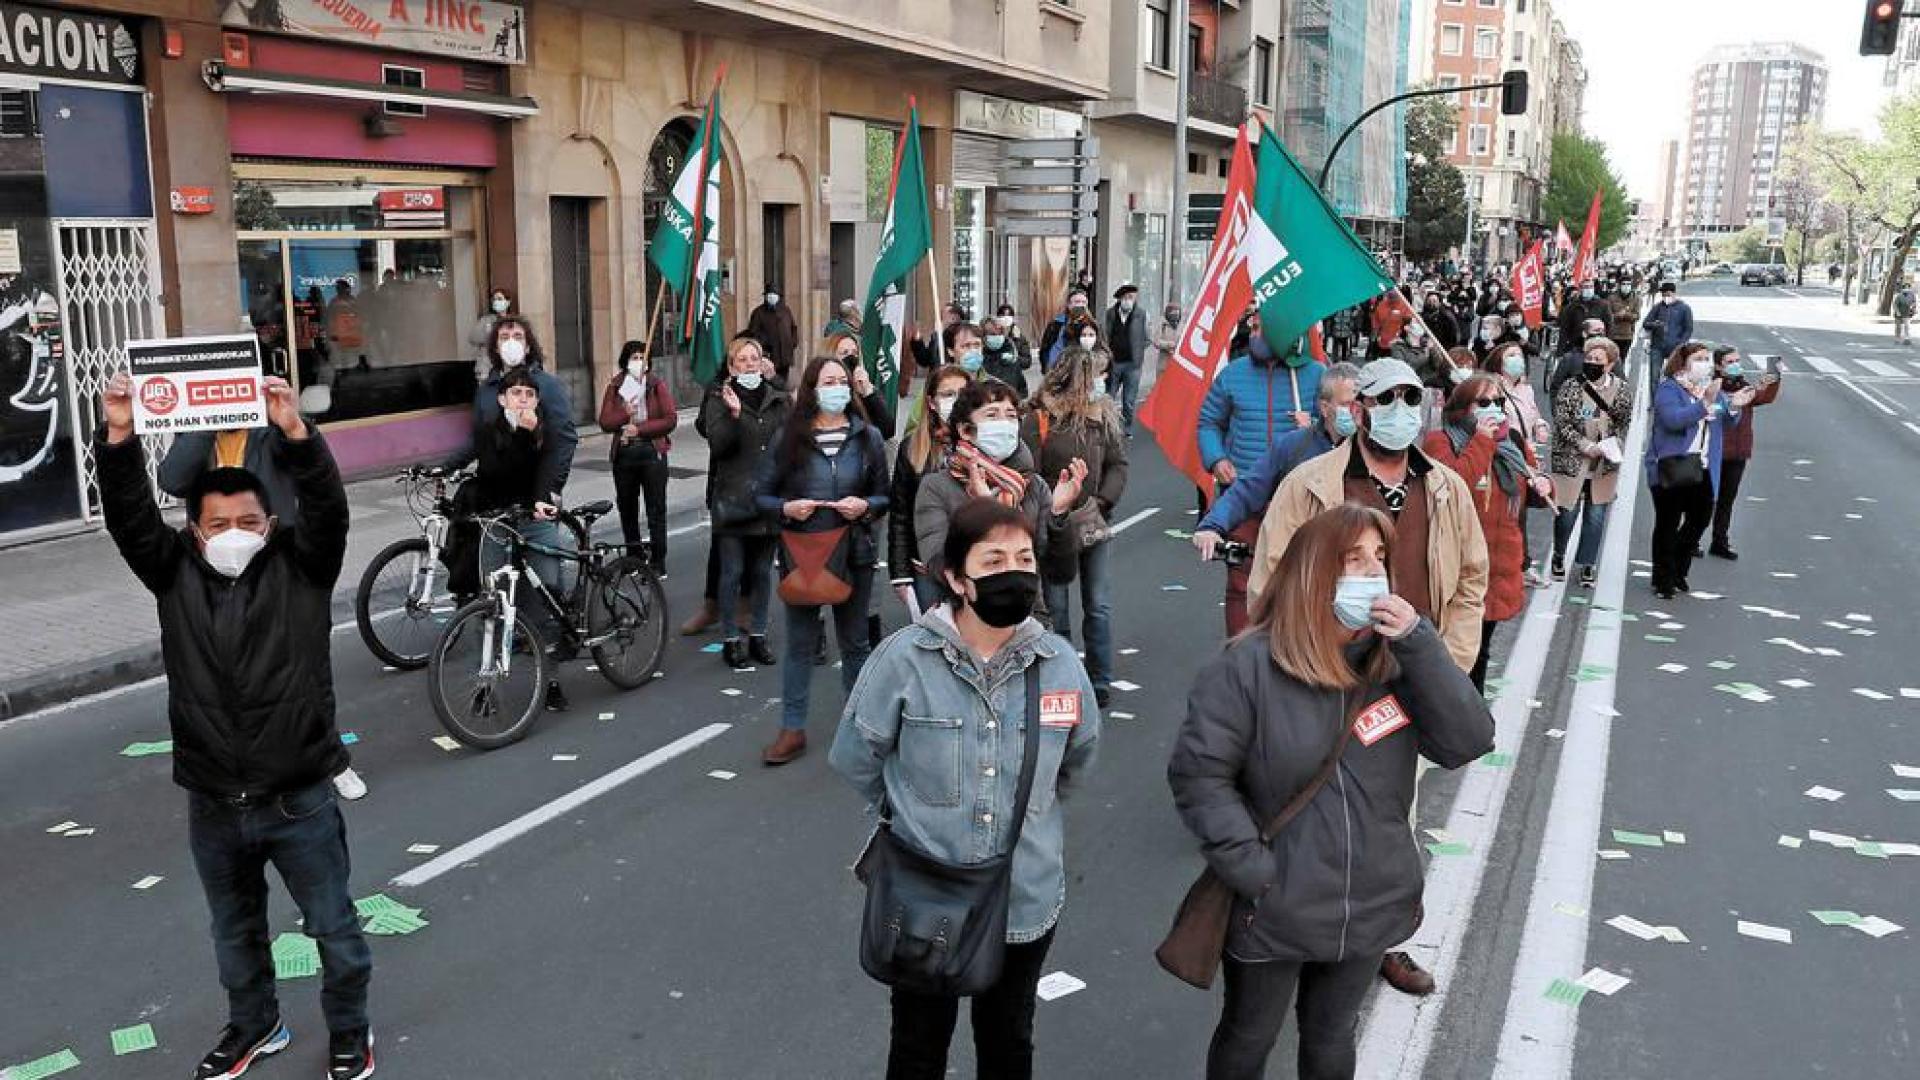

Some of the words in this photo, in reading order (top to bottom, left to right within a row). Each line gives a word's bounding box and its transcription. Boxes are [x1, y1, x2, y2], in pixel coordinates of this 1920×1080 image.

[312, 0, 382, 39] QUERIA
[666, 155, 674, 173] 9
[144, 383, 172, 399] UGT
[191, 383, 251, 400] CCOO
[145, 418, 171, 429] NOS
[174, 416, 201, 426] HAN
[203, 412, 259, 425] VENDIDO
[1355, 702, 1400, 733] LAB
